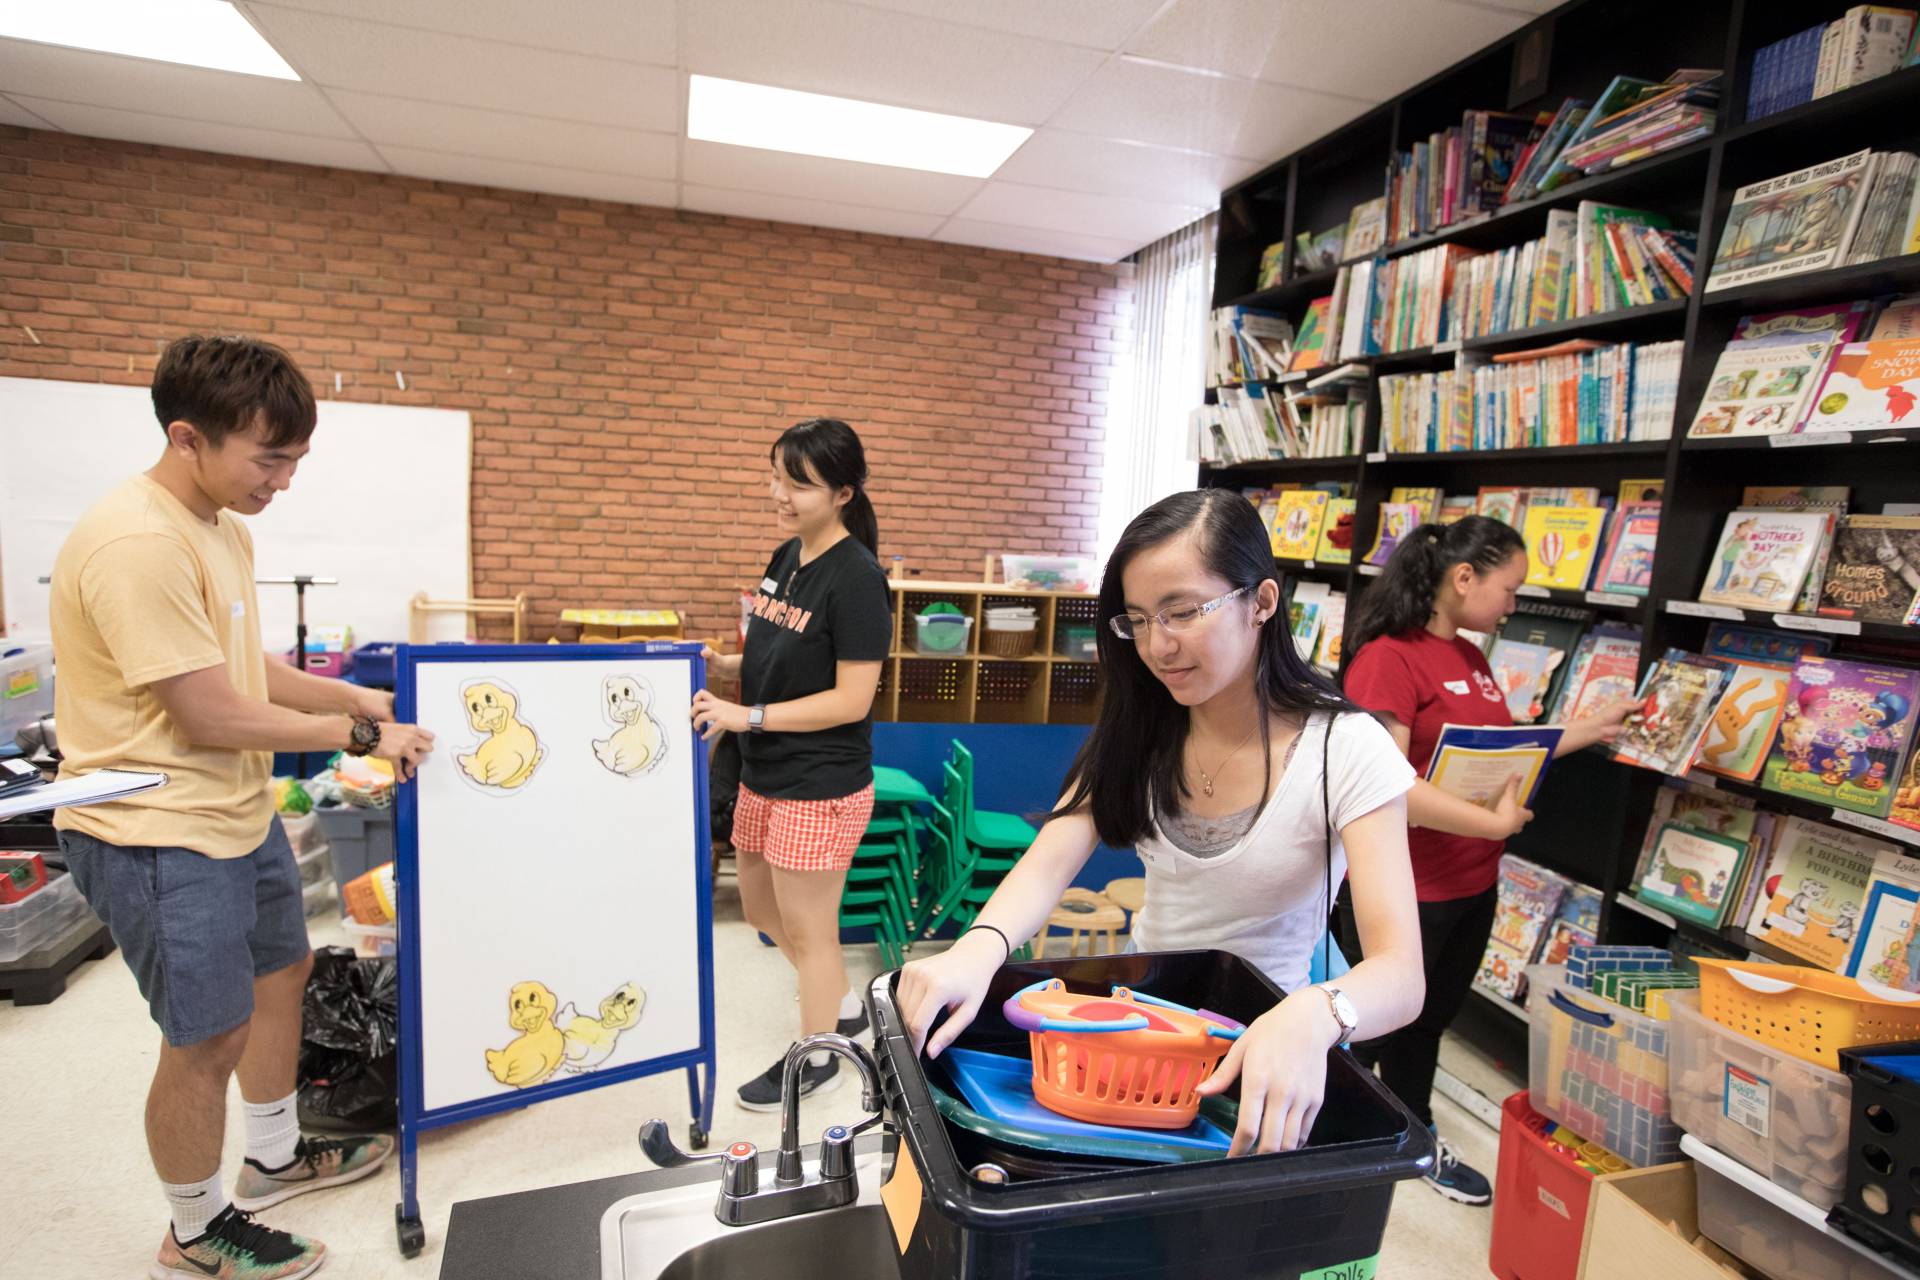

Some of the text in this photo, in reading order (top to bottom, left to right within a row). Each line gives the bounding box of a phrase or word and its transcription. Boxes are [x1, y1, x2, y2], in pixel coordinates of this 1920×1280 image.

[1744, 153, 1865, 199] WHERE THE WILD THINGS ARE
[1871, 356, 1920, 369] SNOW
[1881, 366, 1916, 379] DAY
[1750, 530, 1806, 542] MOTHER'S
[1835, 562, 1886, 580] Homes
[1825, 580, 1889, 604] Ground
[752, 592, 813, 634] PRINCTON
[1516, 601, 1591, 620] MADELINE
[1818, 828, 1841, 841] and
[1841, 834, 1858, 846] the
[1816, 850, 1873, 876] BIRTHDA
[1893, 859, 1920, 874] Lyle
[1806, 860, 1867, 890] FOR FRAN
